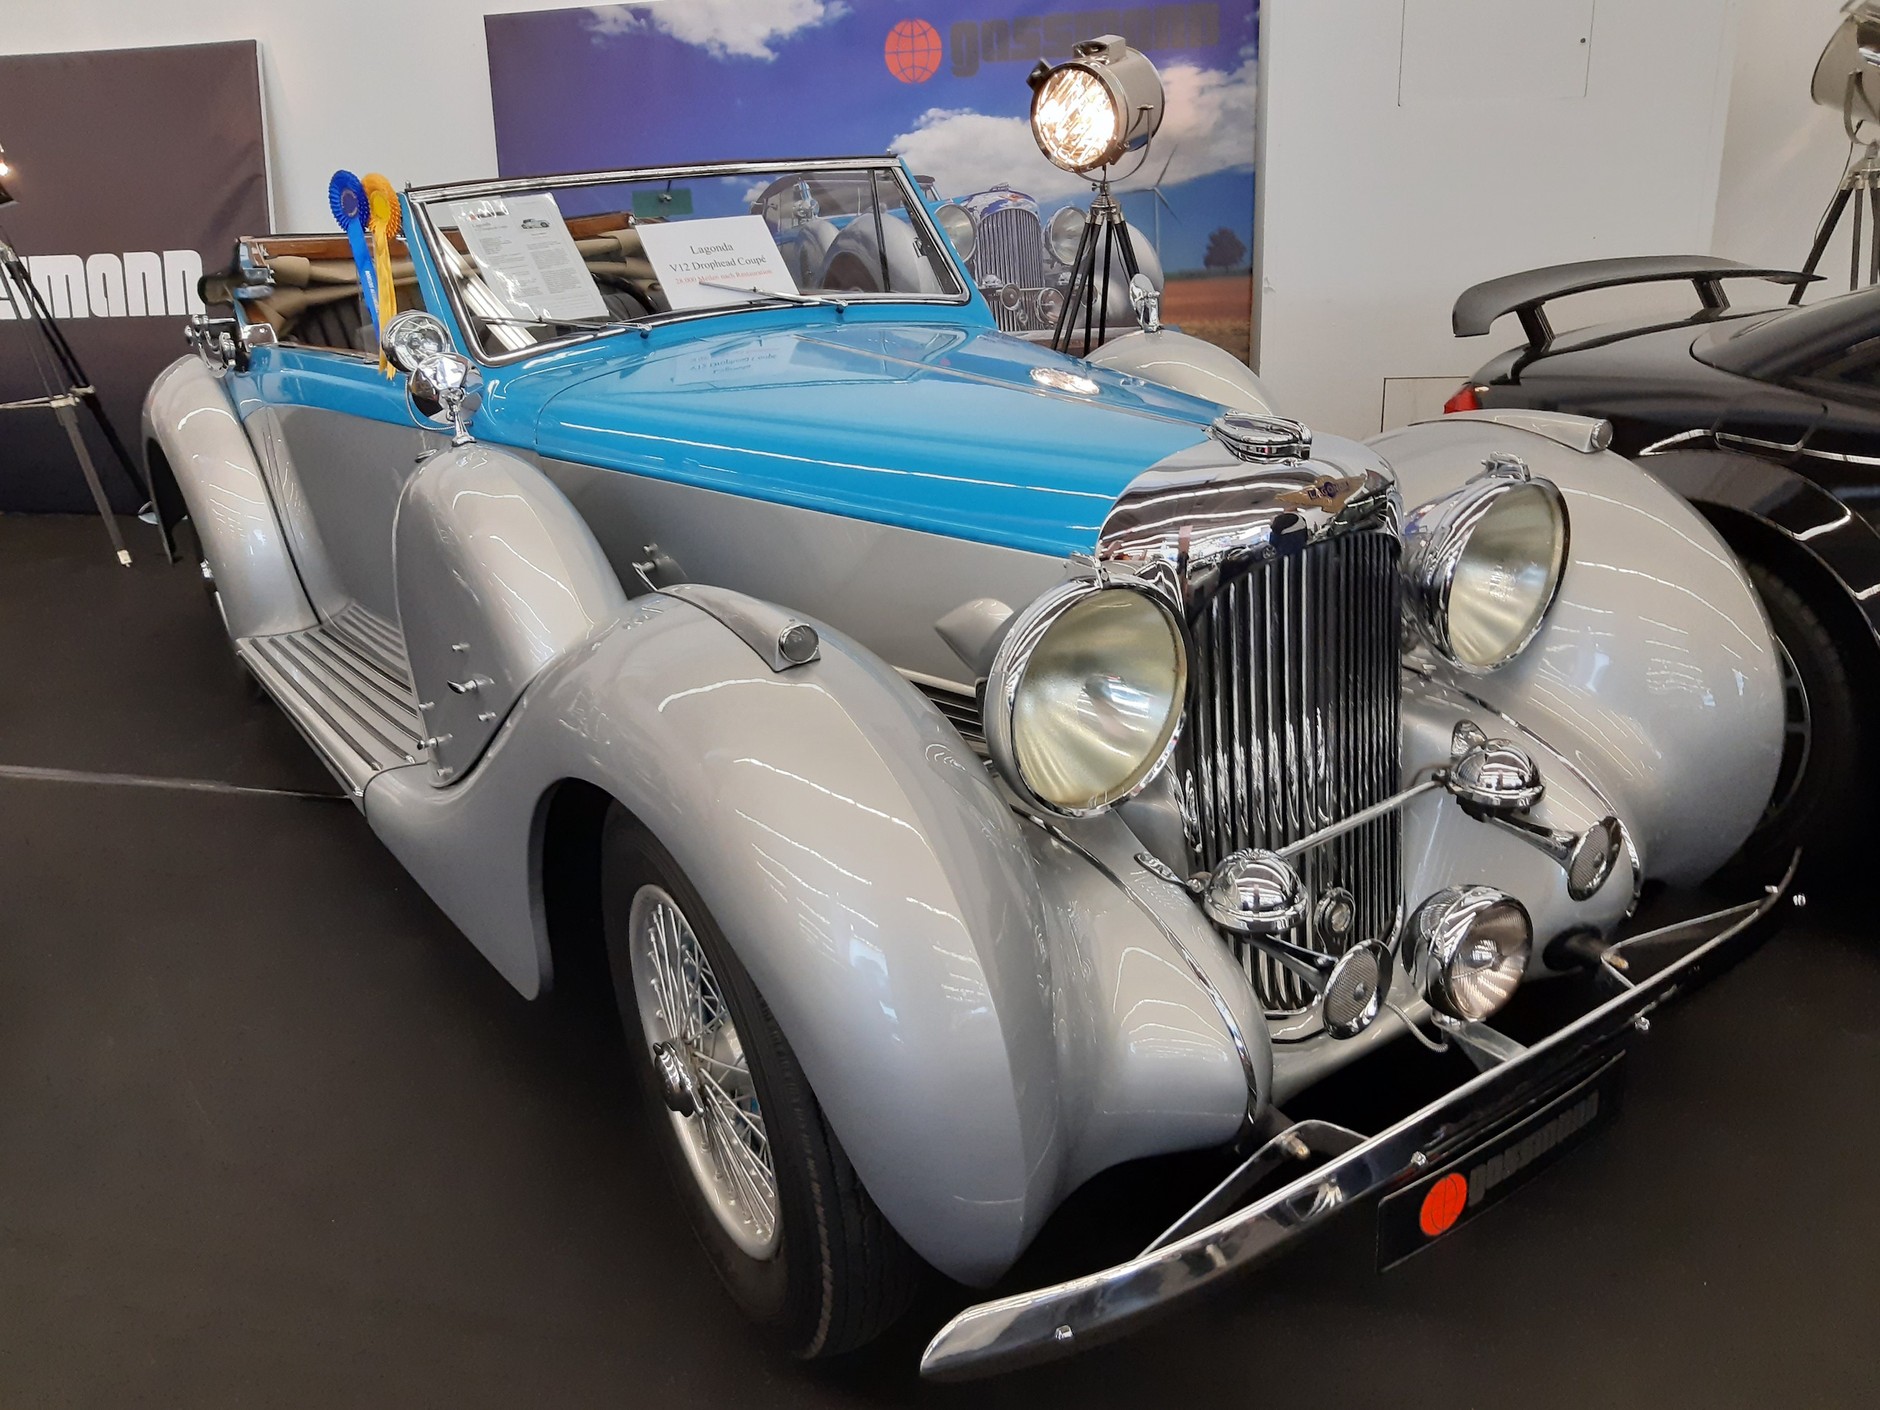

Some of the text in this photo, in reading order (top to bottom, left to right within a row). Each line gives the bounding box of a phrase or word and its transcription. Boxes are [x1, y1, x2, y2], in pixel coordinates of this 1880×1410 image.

[690, 242, 734, 255] Lagonda
[669, 255, 767, 272] V12 Drophead Coupé
